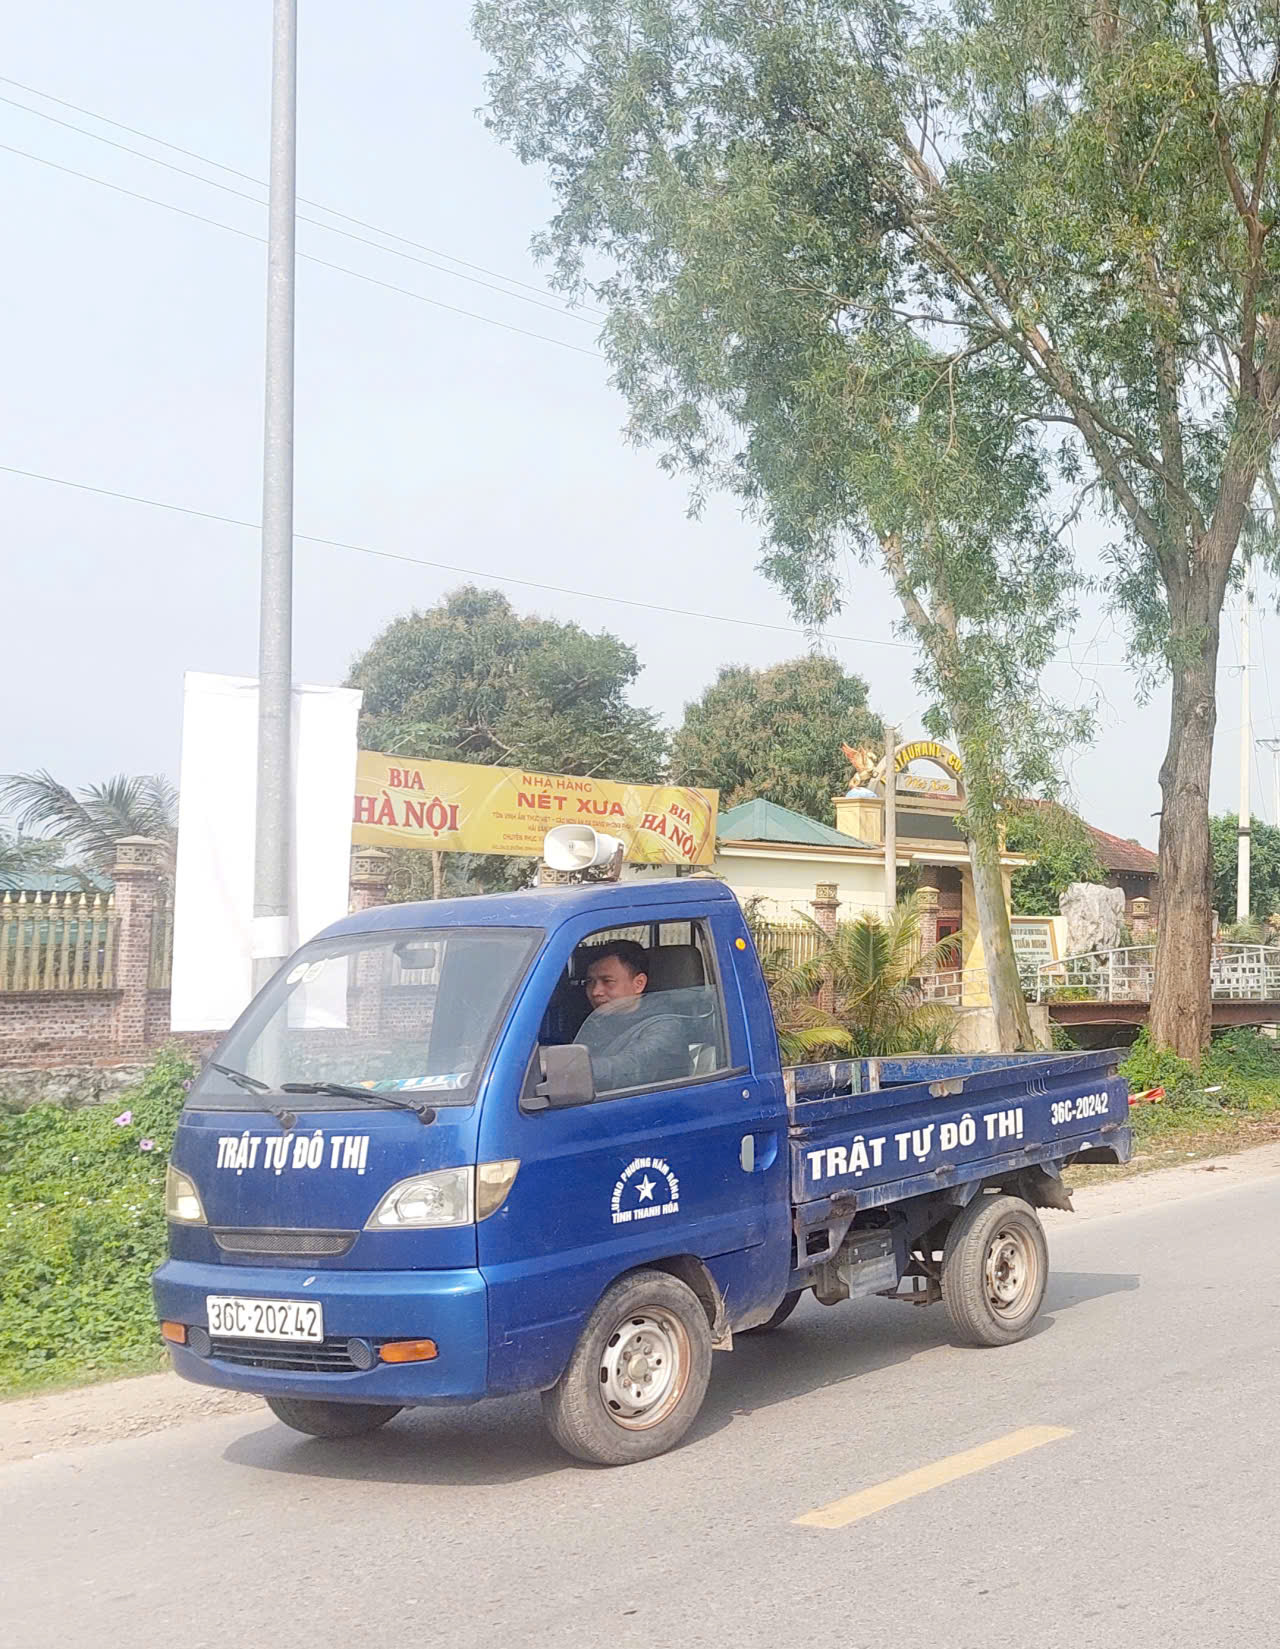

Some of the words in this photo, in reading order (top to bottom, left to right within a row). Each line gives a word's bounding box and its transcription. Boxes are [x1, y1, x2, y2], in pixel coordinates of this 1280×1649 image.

[389, 768, 425, 791] BIA
[522, 774, 552, 790] NHÀ
[556, 777, 592, 794] HÀNG
[353, 790, 398, 826] HÀ
[403, 795, 460, 838] NỘI
[517, 787, 567, 811] NÉT
[576, 799, 625, 817] XƯA
[669, 803, 693, 825] BIA
[640, 813, 667, 837] HÀ
[671, 828, 697, 861] NỘI
[1050, 1092, 1109, 1126] 36C-20242
[216, 1130, 261, 1175] TRẬT
[264, 1133, 293, 1175] TỰ
[292, 1129, 323, 1169] ĐÔ
[330, 1135, 370, 1175] THỊ
[807, 1135, 886, 1181] TRẬT
[895, 1123, 933, 1163] TỰ
[939, 1113, 976, 1151] ĐÔ
[983, 1107, 1025, 1140] THỊ
[611, 1181, 624, 1211] UBND
[611, 1209, 632, 1224] TỈNH
[632, 1205, 661, 1220] THANH
[662, 1201, 679, 1215] HÓA
